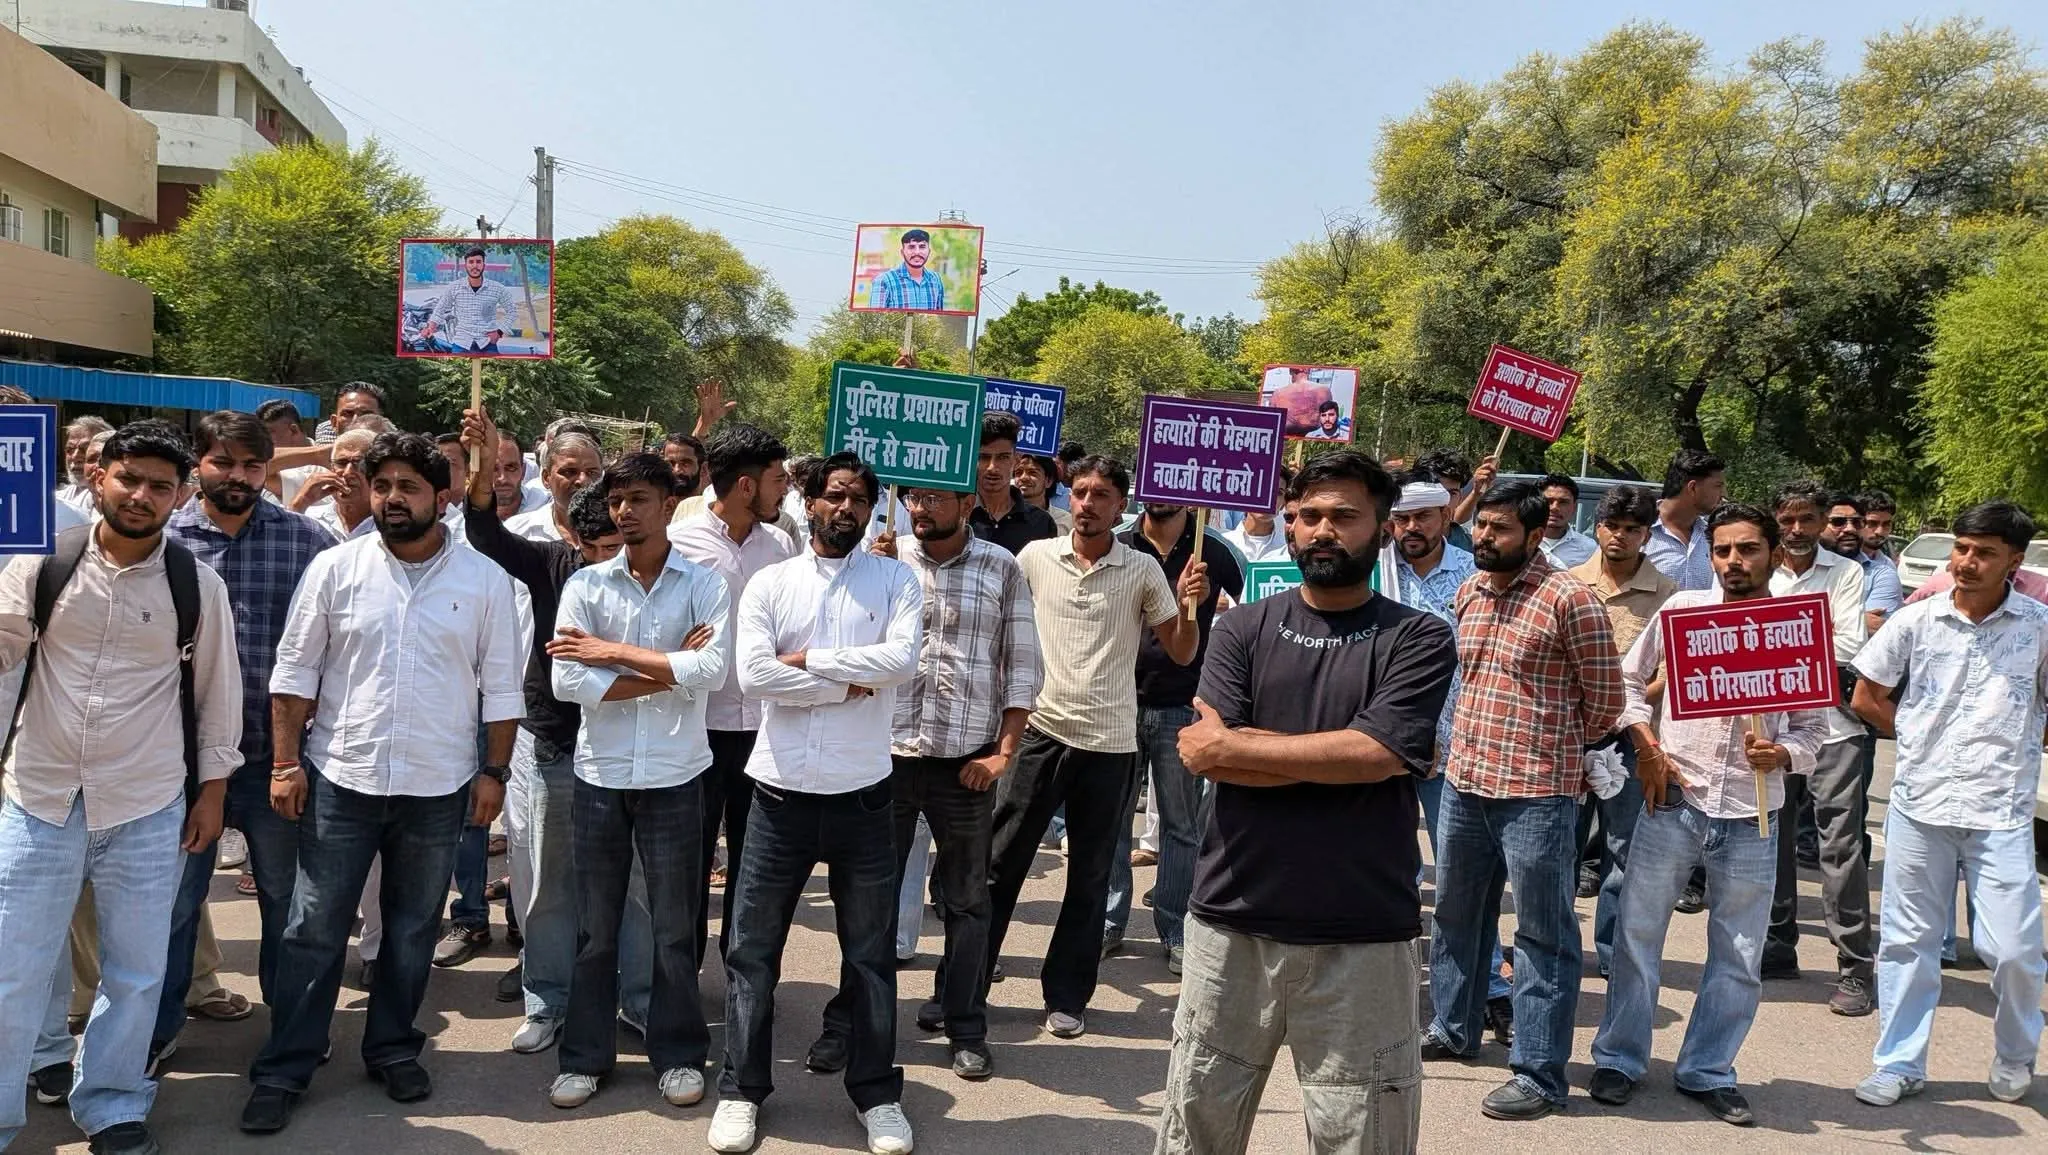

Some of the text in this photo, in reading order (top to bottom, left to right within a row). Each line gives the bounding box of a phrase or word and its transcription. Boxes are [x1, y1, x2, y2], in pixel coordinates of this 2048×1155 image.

[1493, 361, 1570, 400] अशोक के हत्यारों
[845, 380, 970, 428] पुलिस प्रशासन
[1012, 390, 1023, 413] के
[1024, 393, 1056, 418] परिवार
[1481, 386, 1497, 408] को
[1494, 389, 1533, 421] गिरफ्तार
[882, 431, 900, 467] से
[902, 436, 950, 472] जागो
[1025, 421, 1038, 444] दो
[1153, 413, 1273, 454] हत्यारों की मेहमान
[1153, 458, 1200, 491] नवाजी
[1201, 459, 1224, 494] बंद
[1226, 462, 1254, 497] करो
[1277, 621, 1293, 640] HE
[1293, 633, 1343, 649] NORTH
[1685, 609, 1814, 657] अशोक के हत्यारों
[1684, 668, 1708, 702] को
[1710, 666, 1776, 701] गिरफ्तार
